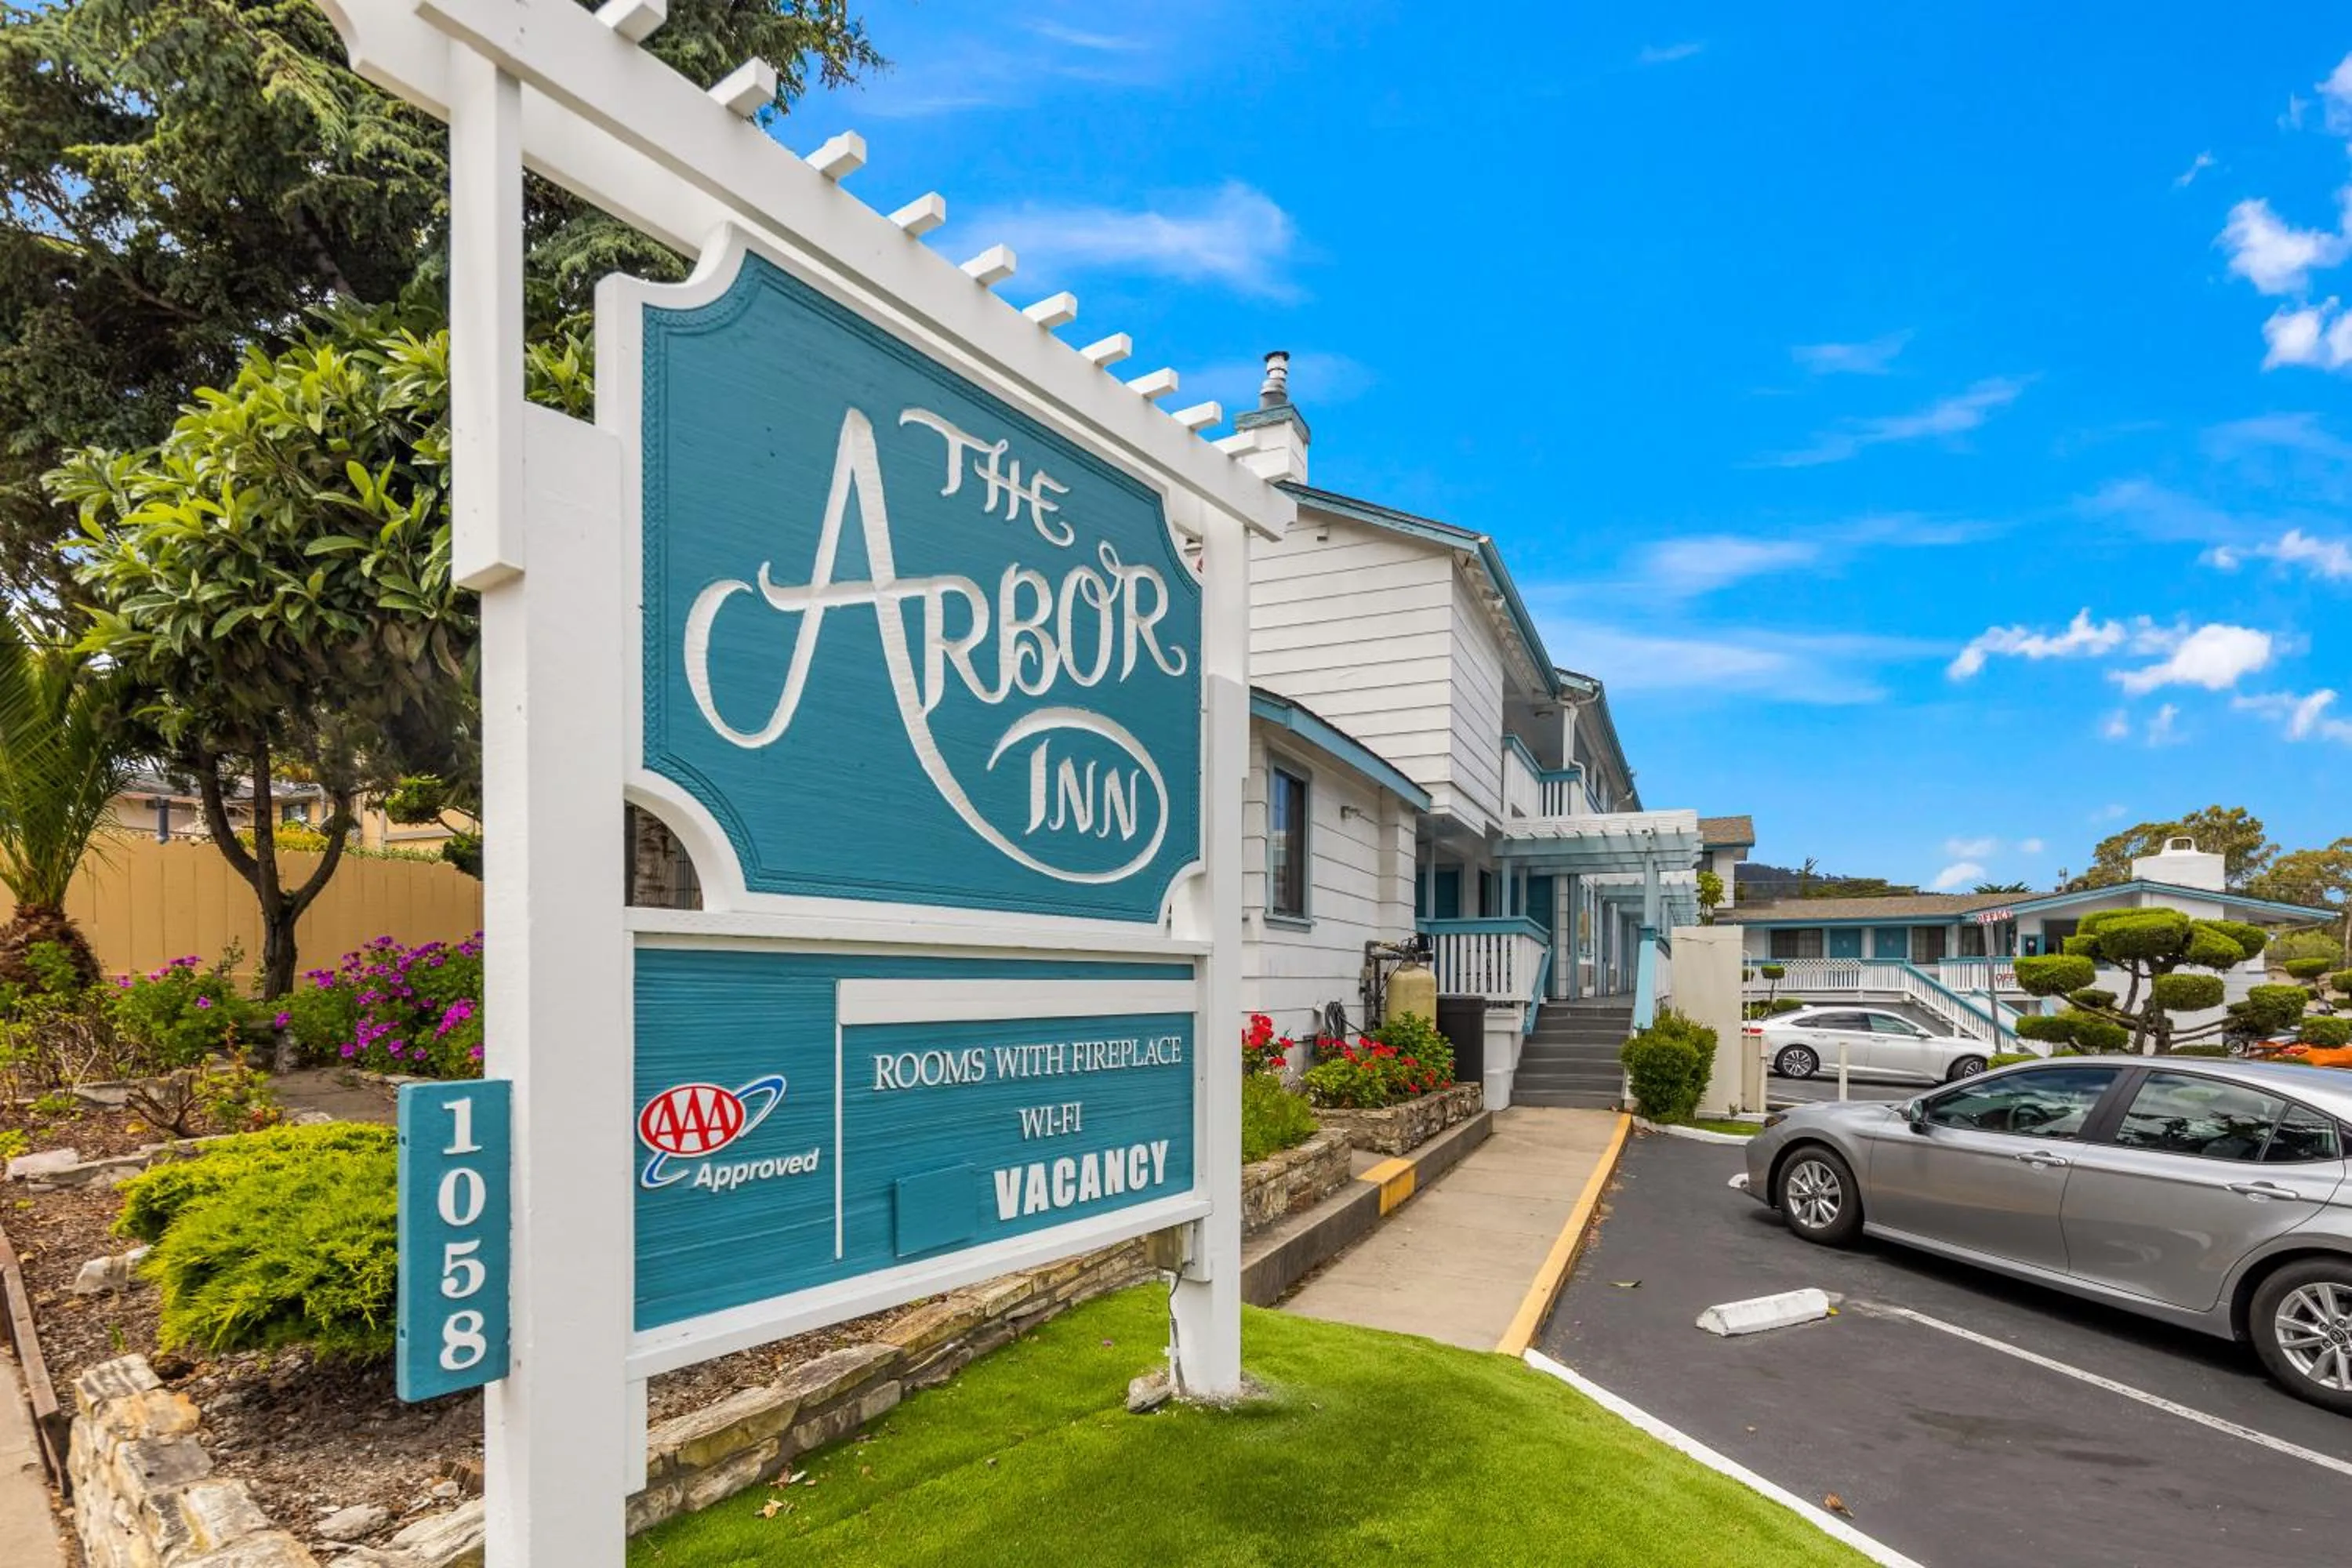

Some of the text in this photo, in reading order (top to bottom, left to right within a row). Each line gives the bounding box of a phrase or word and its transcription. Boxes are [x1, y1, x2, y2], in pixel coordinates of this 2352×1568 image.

[898, 408, 1075, 547] THE
[684, 408, 1187, 749] ARBOR
[1025, 739, 1140, 841] INN
[873, 1036, 1182, 1091] ROOMS WITH FIREPLACE
[647, 1087, 739, 1152] AAA
[1018, 1102, 1082, 1140] WI-FI
[694, 1147, 821, 1192] Approved
[994, 1139, 1169, 1221] VACANCY
[437, 1097, 487, 1370] 1058
